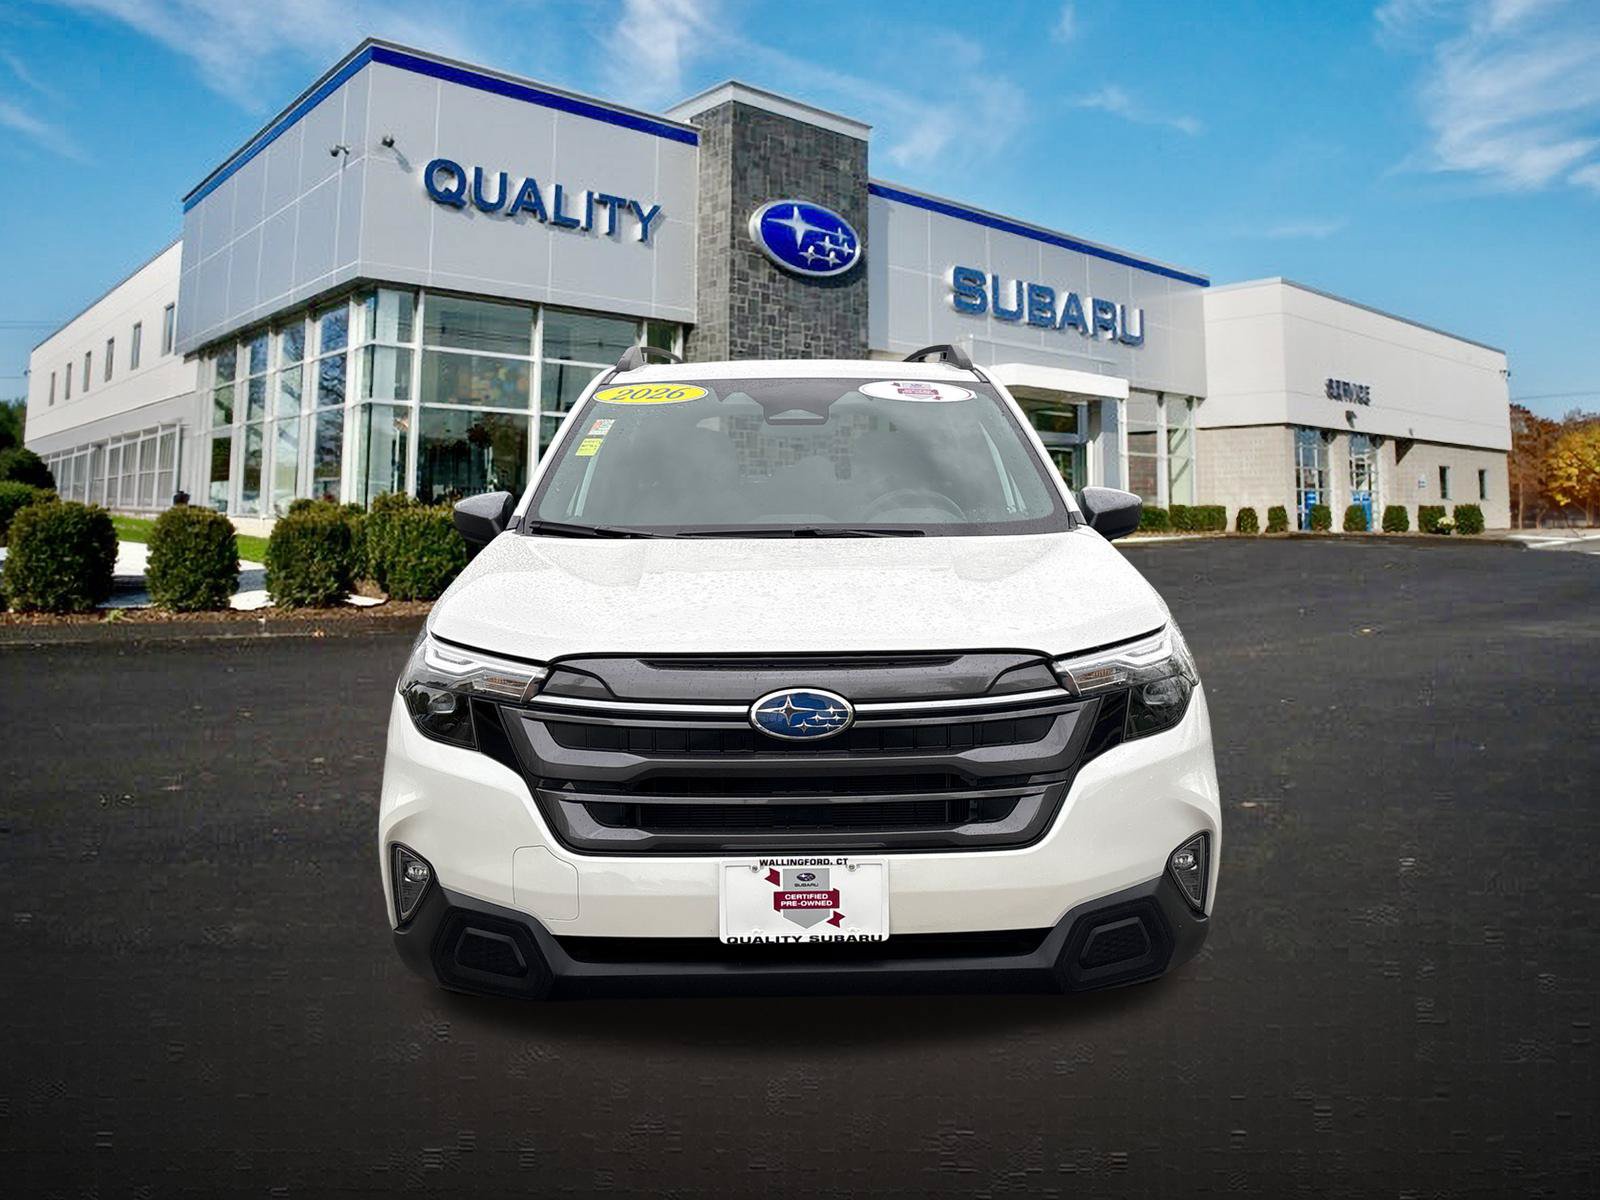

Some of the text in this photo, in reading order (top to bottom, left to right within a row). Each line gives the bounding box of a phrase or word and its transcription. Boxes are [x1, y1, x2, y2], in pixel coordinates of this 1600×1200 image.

[423, 158, 662, 242] QUALITY
[949, 265, 1145, 346] SUBARU
[611, 387, 688, 400] 2026
[727, 934, 883, 944] QUALITY SUBARU
